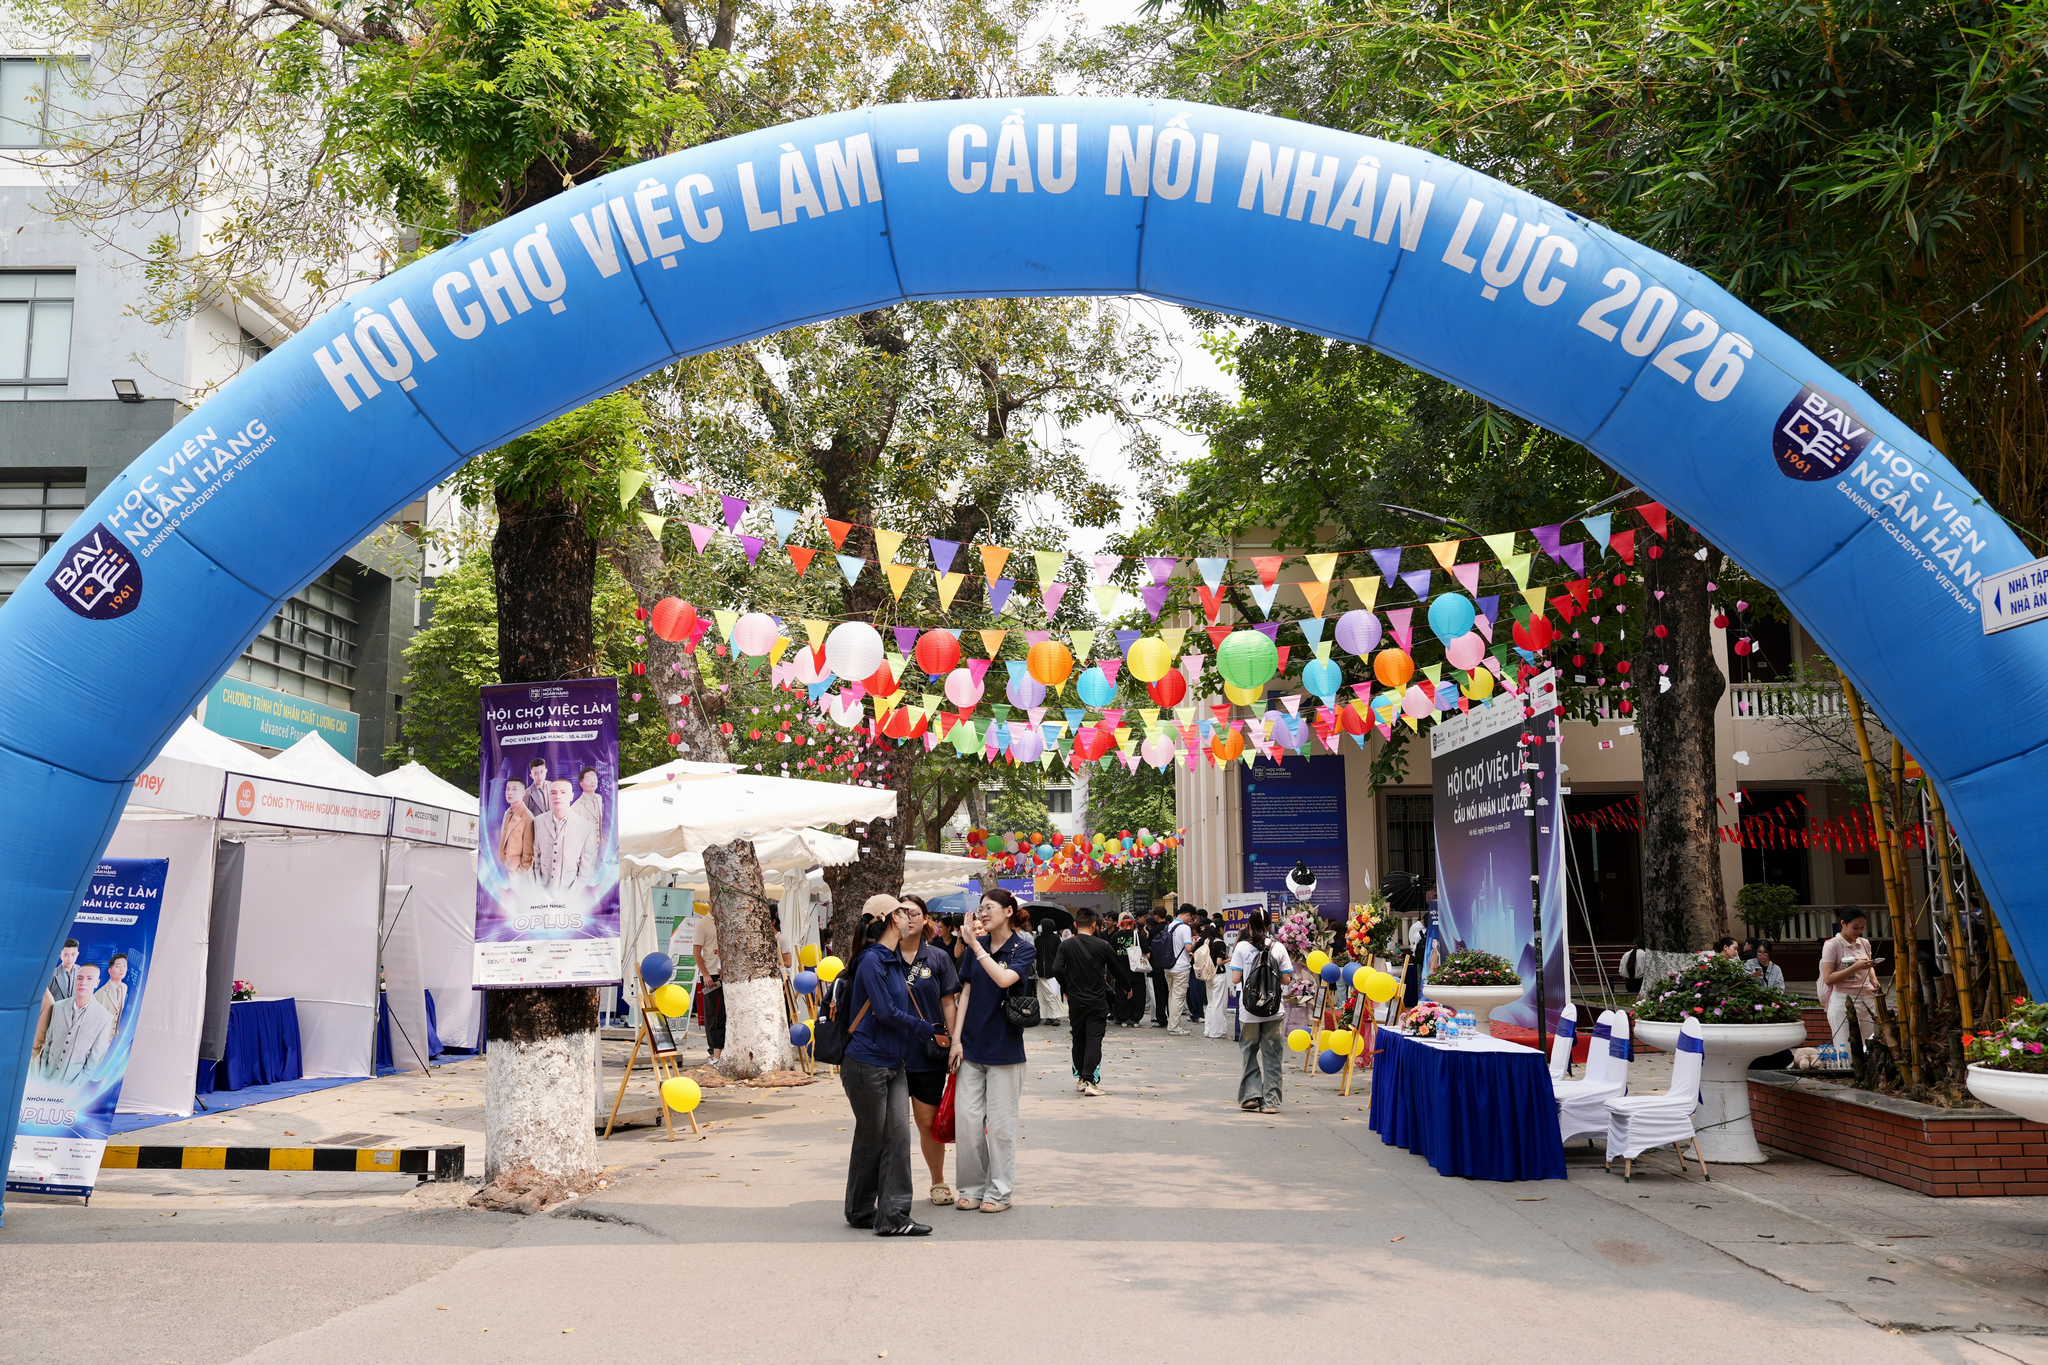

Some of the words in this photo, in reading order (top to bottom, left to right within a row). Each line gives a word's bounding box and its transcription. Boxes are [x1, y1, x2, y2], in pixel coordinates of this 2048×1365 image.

[312, 298, 438, 412] HỘI
[432, 222, 567, 340] CHỢ
[570, 176, 724, 279] VIỆC
[737, 132, 883, 232] LÀM
[947, 108, 1077, 194] CẦU
[1105, 112, 1219, 204] NỐI
[1237, 140, 1435, 252] NHÂN
[1441, 197, 1578, 306] LỰC
[1577, 267, 1754, 402] 2026
[1802, 392, 1866, 441] BAV
[1783, 449, 1811, 473] 1961
[124, 477, 197, 547] NGÂN
[193, 418, 268, 483] HÀNG
[141, 518, 181, 557] BANKING
[180, 479, 223, 521] ACADEMY
[222, 469, 236, 483] OF
[233, 434, 277, 471] VIETNAM
[1850, 460, 1928, 532] NGÂN
[107, 475, 159, 529] HỌC
[1870, 440, 1930, 493] HỌC
[1931, 490, 1986, 555] VIỆN
[1836, 480, 1880, 519] BANKING
[1878, 517, 1926, 565] ACADEMY
[1922, 559, 1937, 573] OF
[1934, 569, 1977, 614] VIETNAM
[55, 532, 105, 591] BAV
[2008, 574, 2029, 595] NHÀ
[2030, 568, 2048, 588] TẬP
[108, 584, 134, 609] 1961
[2010, 594, 2031, 615] NHÀ
[2033, 591, 2048, 609] ĂN
[222, 688, 252, 709] CHƯƠNG
[252, 695, 272, 714] TRÌNH
[272, 697, 283, 717] CỬ
[282, 702, 300, 722] NHÂN
[300, 708, 316, 726] CHẤT
[316, 715, 335, 731] LƯỢNG
[335, 719, 348, 734] CAO
[487, 708, 511, 722] HỘI
[515, 706, 544, 719] CHỢ
[548, 703, 579, 718] VIỆC
[584, 701, 612, 714] LÀM
[495, 721, 514, 732] CẦU
[516, 720, 532, 730] NỐI
[535, 718, 560, 728] NHÂN
[562, 718, 580, 728] LỰC
[260, 718, 289, 739] Advanced
[134, 773, 165, 796] oney
[1447, 766, 1463, 800] HỘI
[1464, 758, 1484, 794] CHỢ
[1486, 750, 1509, 788] VIỆC
[238, 800, 252, 808] now
[242, 788, 250, 798] up
[261, 793, 283, 808] CÔNG
[285, 798, 295, 810] TY
[296, 800, 315, 813] TNHH
[358, 808, 381, 822] NGHIỆP
[1454, 803, 1465, 824] CẦU
[1466, 799, 1478, 821] NỐI
[1479, 796, 1496, 818] NHÂN
[1497, 793, 1510, 817] LỰC
[1512, 793, 1528, 810] 2026
[82, 899, 102, 908] HÂN
[104, 900, 122, 910] LỰC
[124, 902, 146, 910] 2026
[93, 883, 124, 899] VIỆC
[128, 885, 158, 899] LÀM
[513, 914, 584, 930] OPLUS
